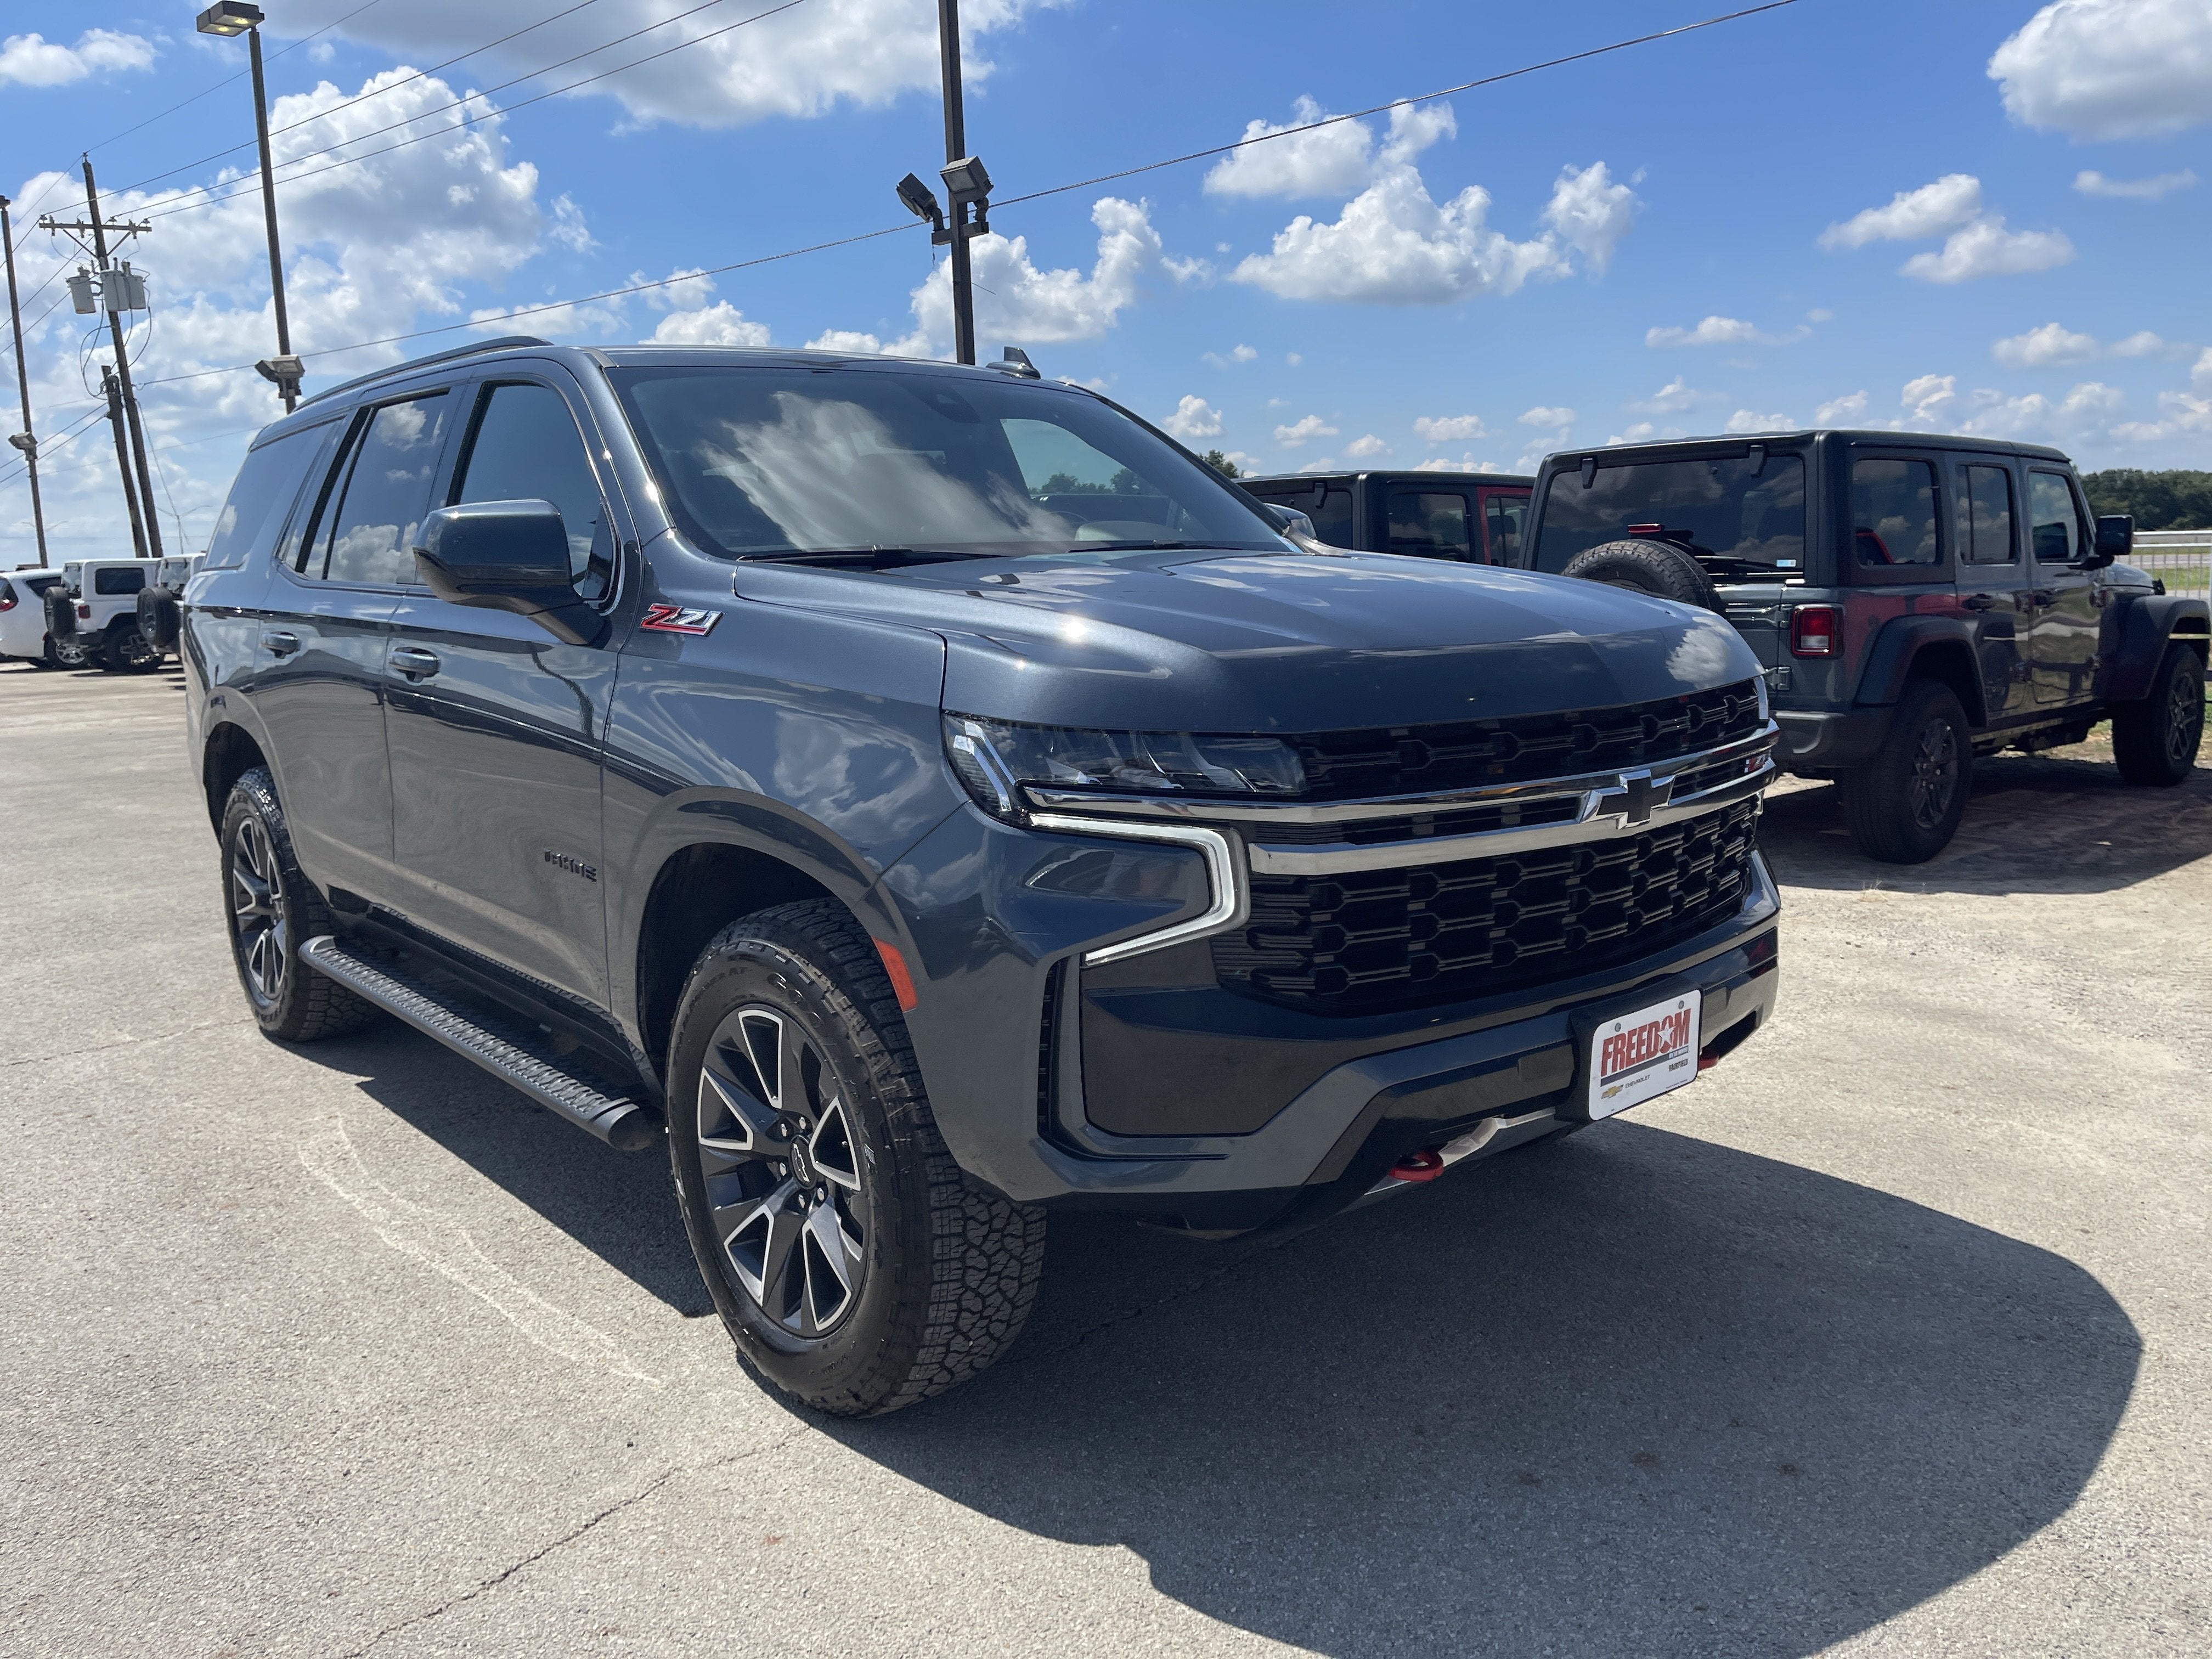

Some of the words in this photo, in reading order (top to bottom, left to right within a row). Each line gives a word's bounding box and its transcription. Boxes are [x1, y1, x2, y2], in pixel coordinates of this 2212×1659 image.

[640, 603, 724, 637] Z71
[1600, 1008, 1691, 1077] FREEDOM
[1625, 1074, 1650, 1088] CHEVROLET
